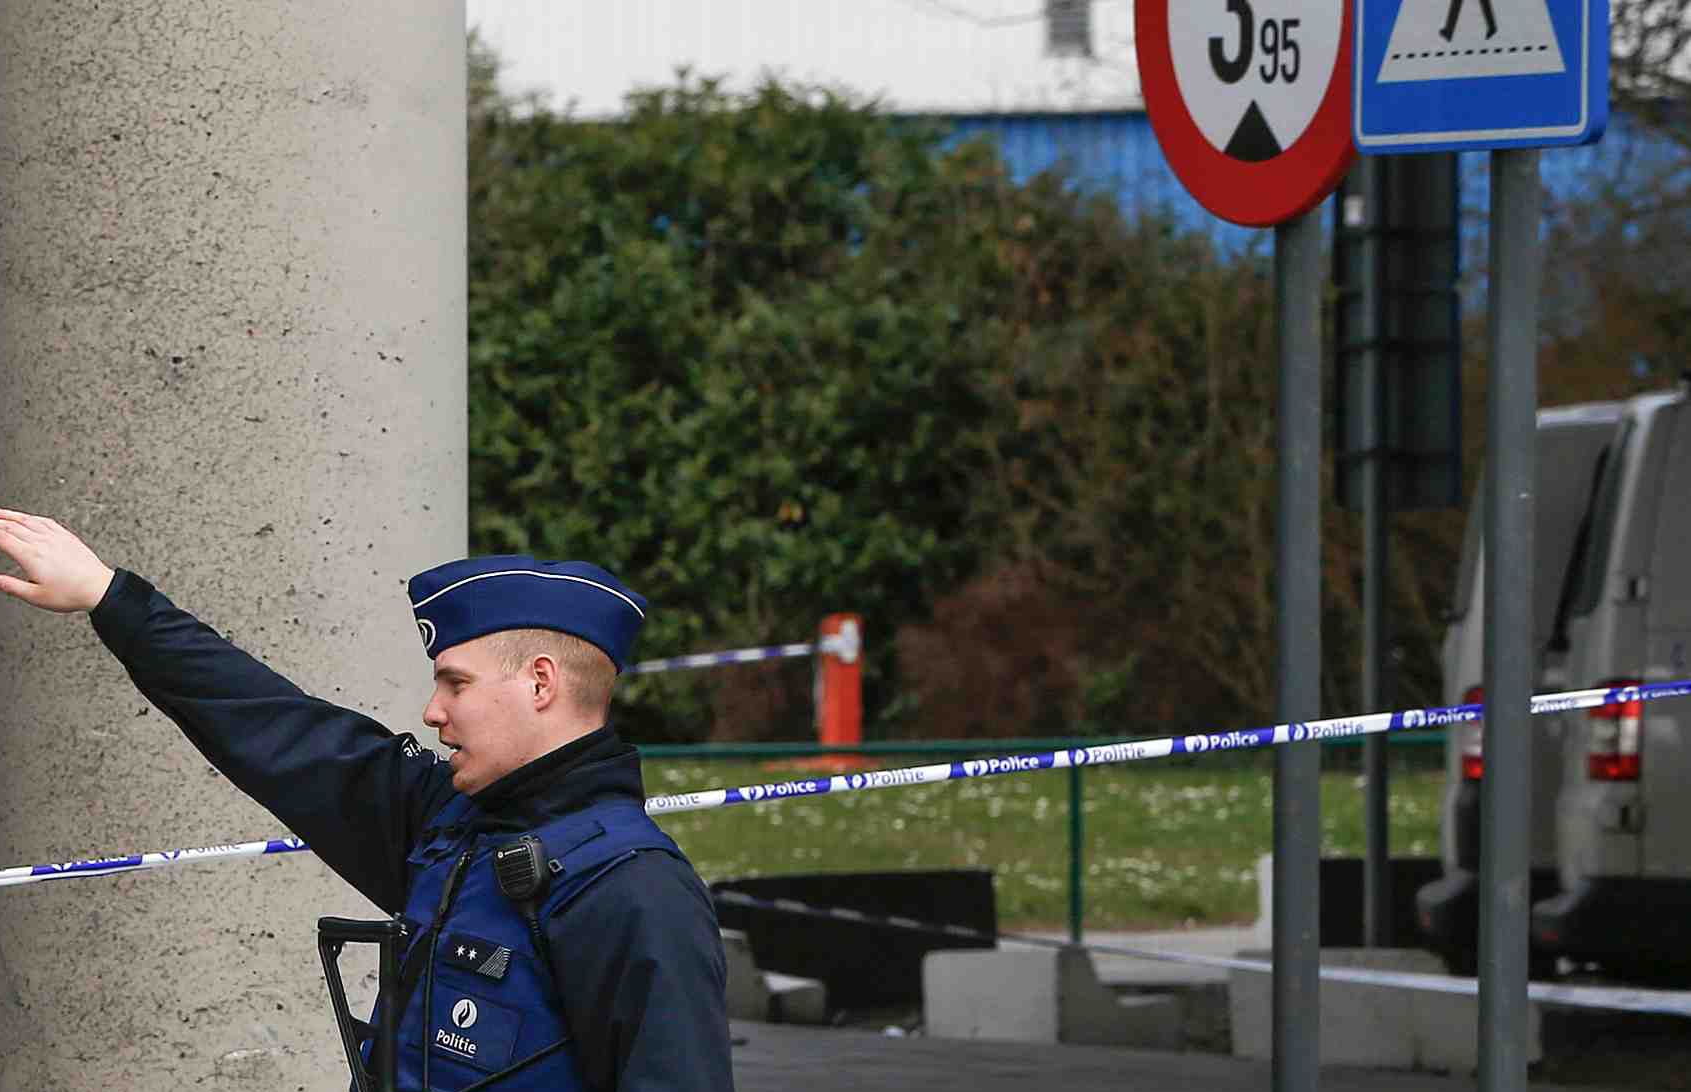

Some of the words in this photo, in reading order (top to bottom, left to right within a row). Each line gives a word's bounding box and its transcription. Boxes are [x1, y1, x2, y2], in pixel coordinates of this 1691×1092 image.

[764, 780, 817, 797] Police
[870, 768, 926, 786] Politie
[988, 755, 1040, 773] Police
[1209, 731, 1259, 750] Police
[436, 1028, 477, 1054] Politie
